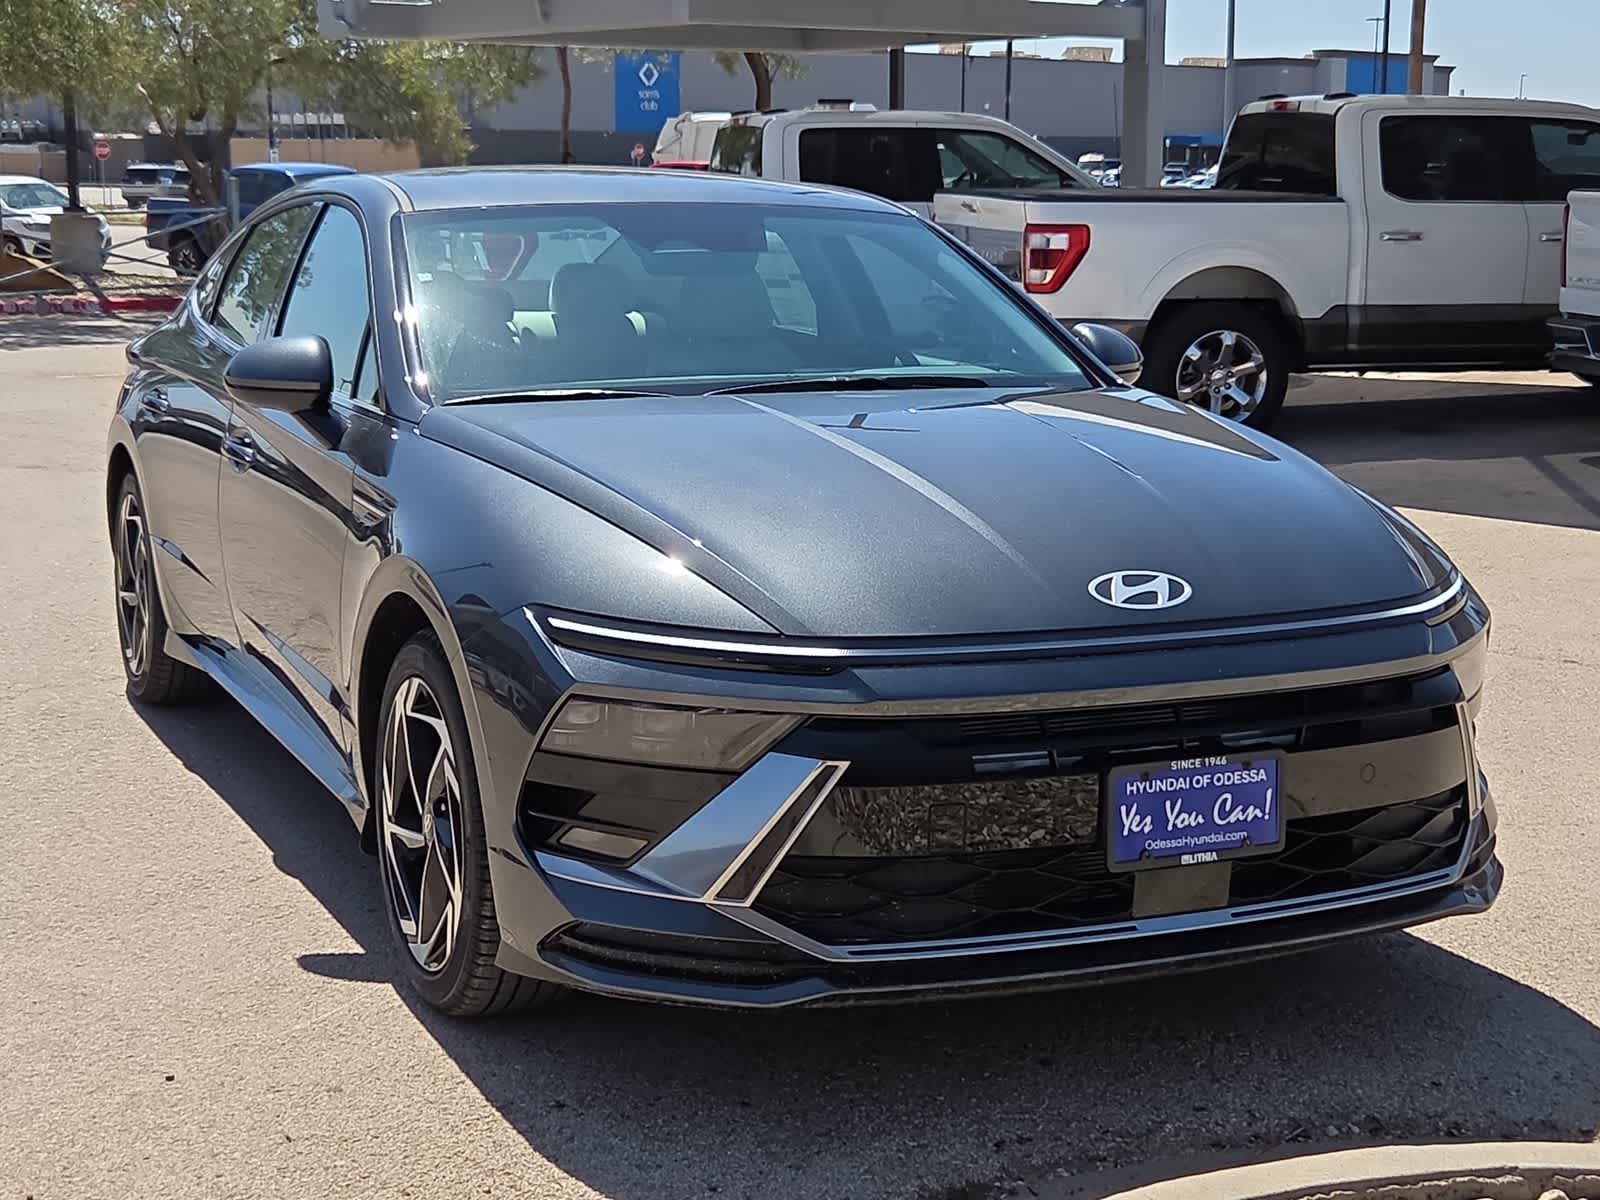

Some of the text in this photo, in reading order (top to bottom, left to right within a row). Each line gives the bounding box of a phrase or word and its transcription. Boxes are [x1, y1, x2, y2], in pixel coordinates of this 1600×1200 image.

[640, 100, 658, 111] club
[1170, 755, 1227, 771] SINCE 1946
[1126, 768, 1267, 795] HYUNDAI OF ODESSA
[1120, 788, 1273, 836] Yes You Can!
[1145, 831, 1248, 851] OdessaHyundai.com
[1190, 851, 1218, 864] LITHIA
